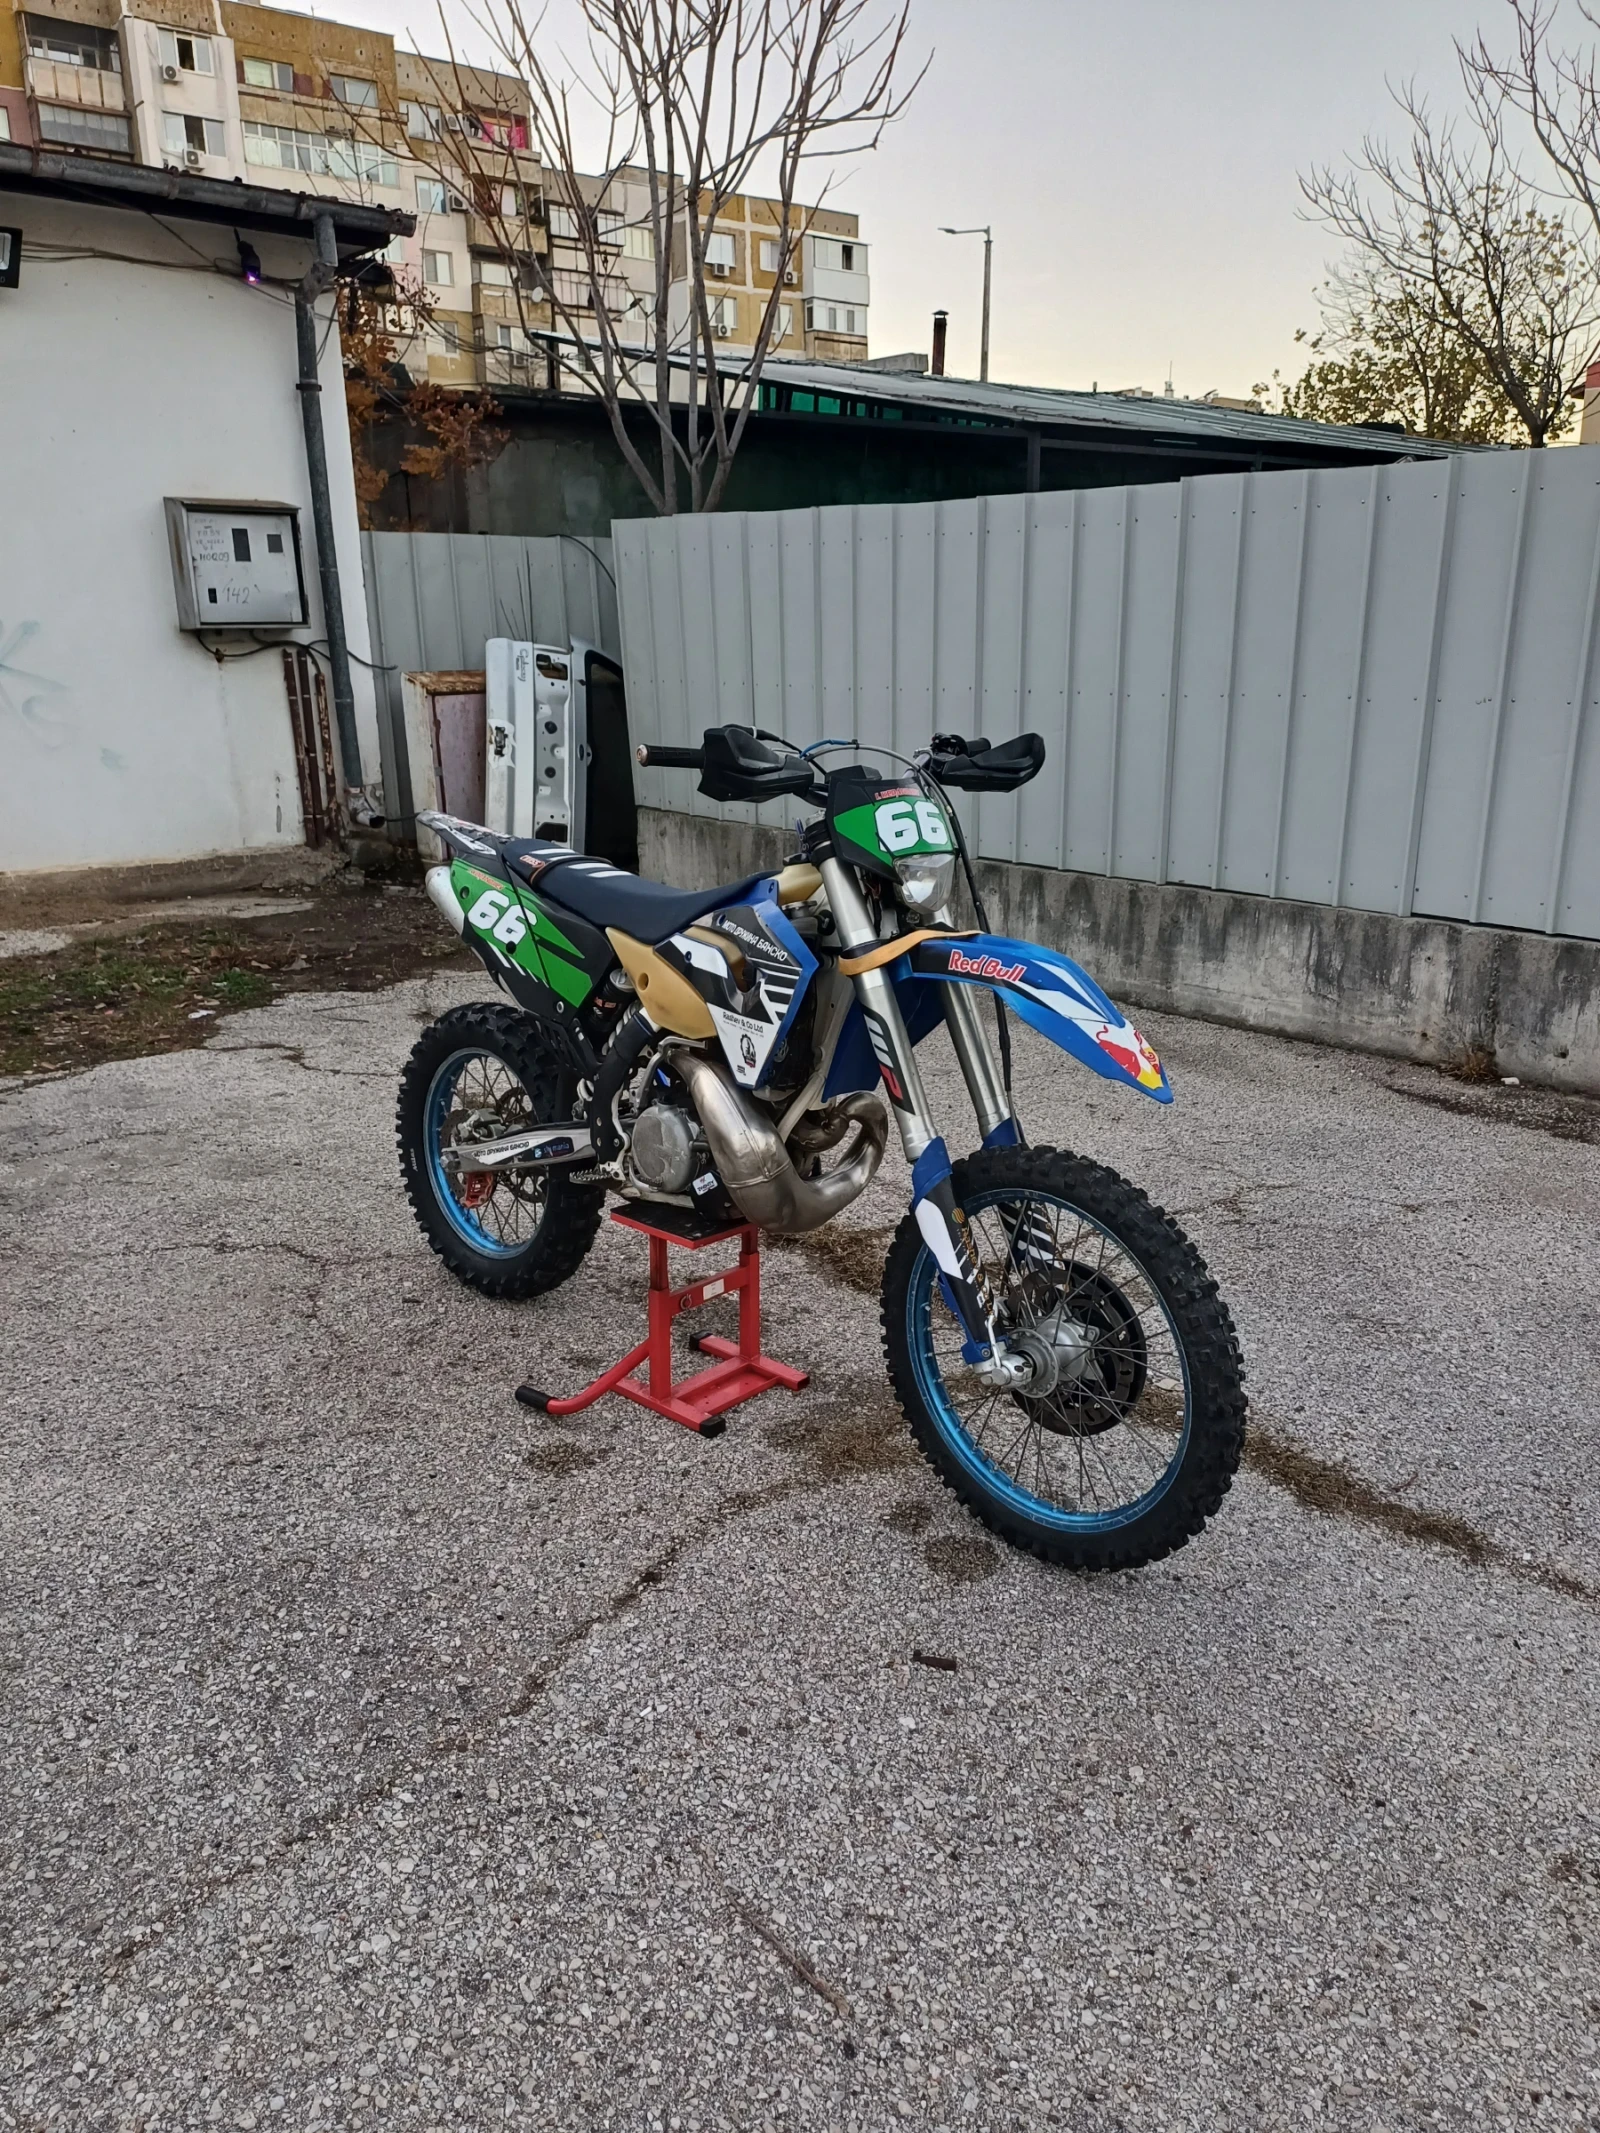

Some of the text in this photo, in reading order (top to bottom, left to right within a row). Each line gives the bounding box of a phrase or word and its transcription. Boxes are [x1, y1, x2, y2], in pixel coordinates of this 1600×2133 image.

[874, 800, 948, 853] 66
[467, 889, 538, 946] 66
[756, 938, 788, 962] БАНСКО
[948, 949, 1028, 982] Red Bull
